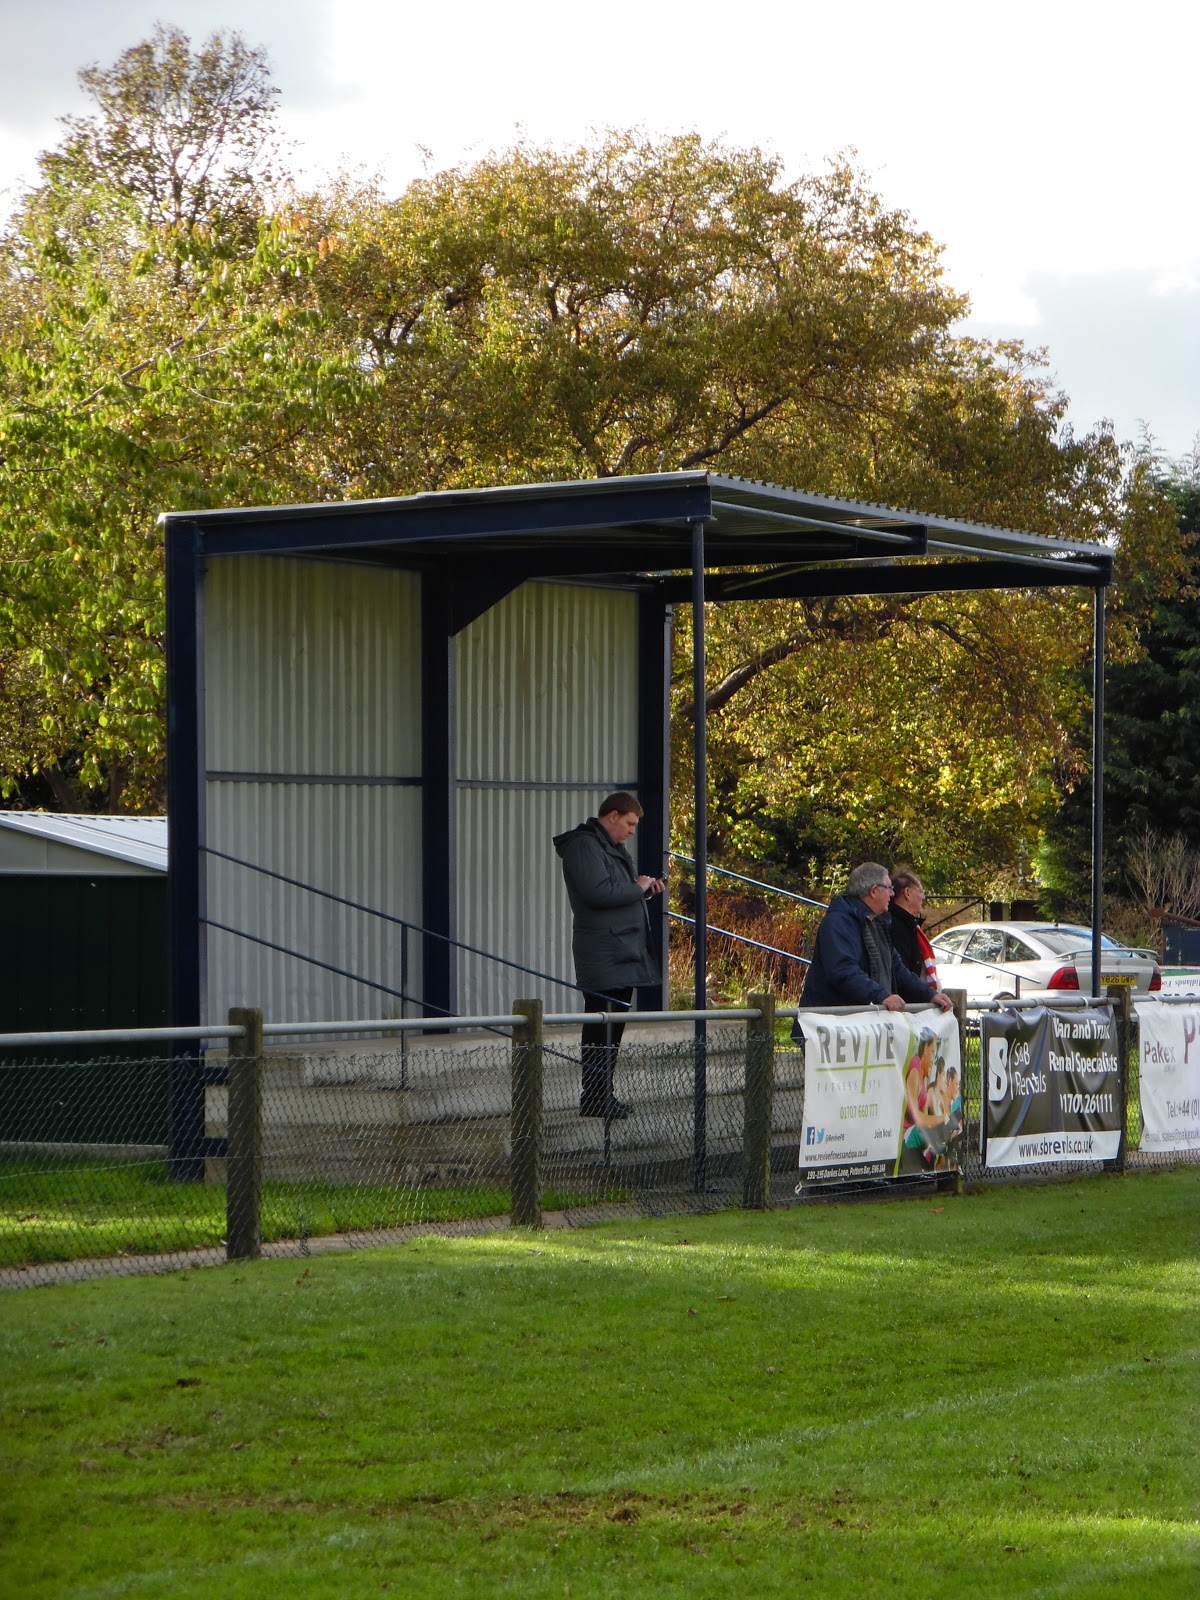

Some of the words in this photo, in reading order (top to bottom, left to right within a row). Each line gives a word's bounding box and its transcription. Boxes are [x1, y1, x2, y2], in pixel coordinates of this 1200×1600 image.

[1053, 1017, 1071, 1038] Van
[1072, 1018, 1091, 1039] and
[1014, 1041, 1031, 1066] S&B
[1144, 1040, 1176, 1063] Pakex
[1075, 1052, 1118, 1078] Specialists
[1014, 1070, 1047, 1096] Rentals
[840, 1106, 856, 1120] 01707
[858, 1105, 868, 1118] 660
[869, 1104, 878, 1117] 777
[874, 1129, 882, 1139] Join
[804, 1148, 868, 1163] www.revivefitnessandspa.co.uk
